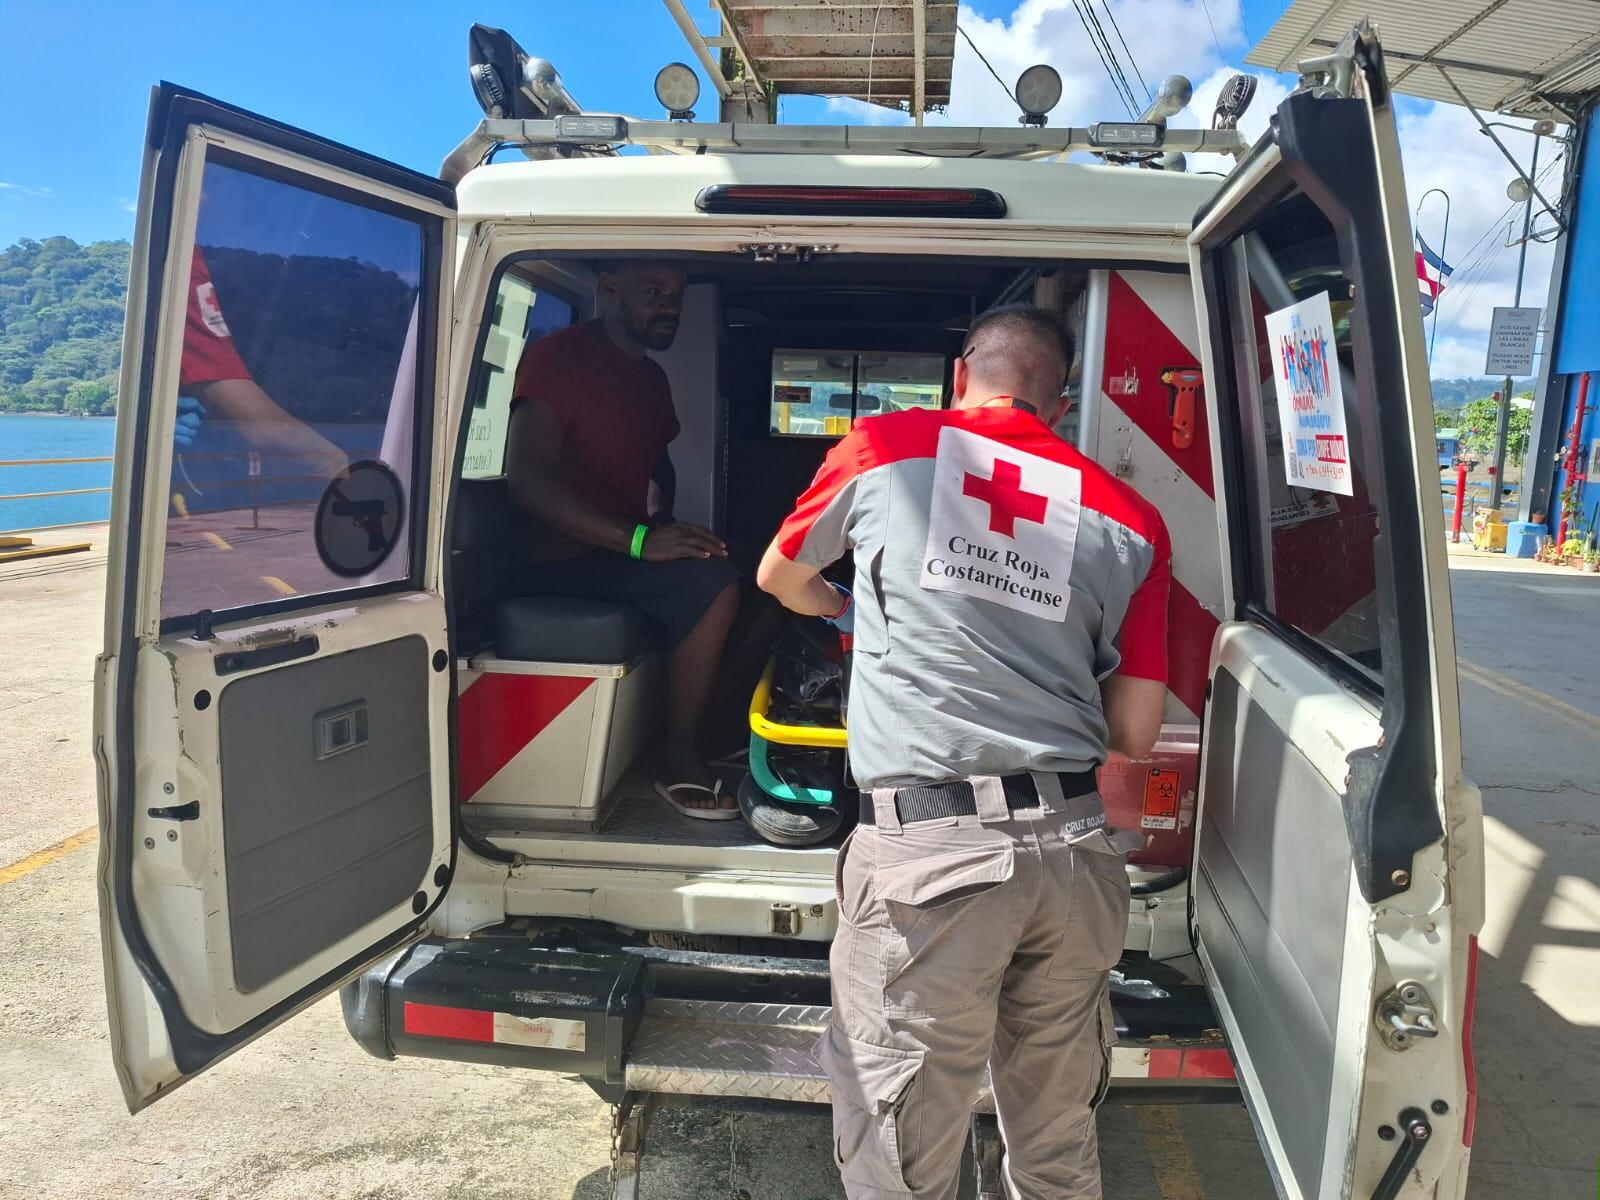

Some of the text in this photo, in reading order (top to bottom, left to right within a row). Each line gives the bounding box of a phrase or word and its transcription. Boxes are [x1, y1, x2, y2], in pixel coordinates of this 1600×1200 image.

[948, 536, 1050, 580] Cruz Roja
[926, 558, 1063, 608] Costarricense
[1065, 818, 1087, 834] CRUZ
